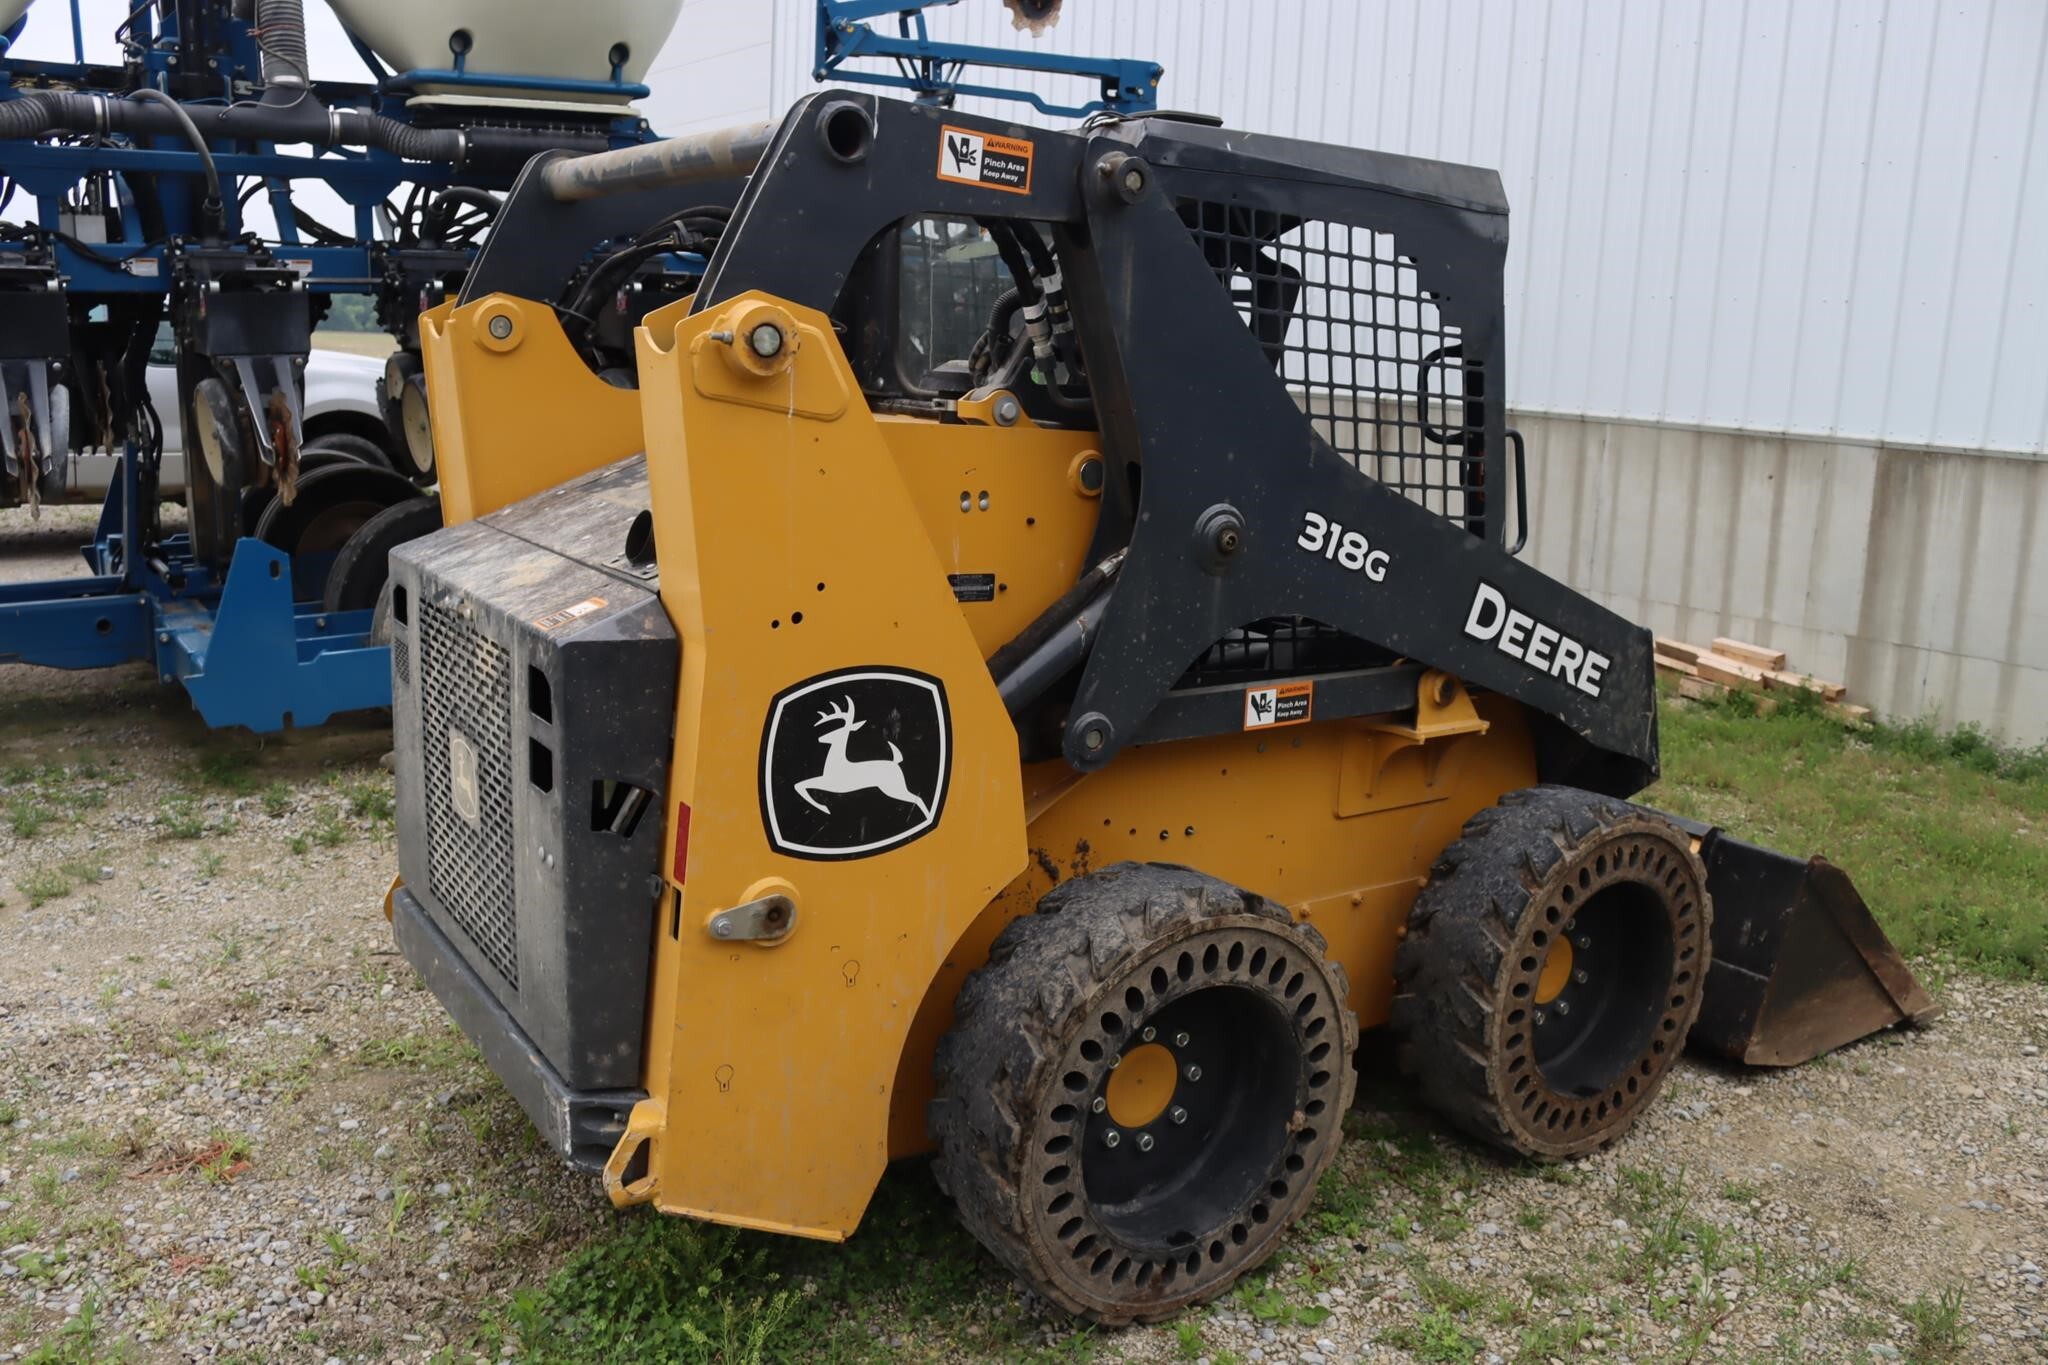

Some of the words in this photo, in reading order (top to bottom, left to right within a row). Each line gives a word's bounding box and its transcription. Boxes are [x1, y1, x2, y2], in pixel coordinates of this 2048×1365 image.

[993, 141, 1028, 153] WARNING
[984, 157, 1006, 169] Pinch
[1007, 162, 1025, 172] Area
[983, 169, 1000, 179] Keep
[1001, 172, 1019, 182] Away
[1297, 511, 1390, 582] 318G
[1464, 582, 1611, 698] DEERE
